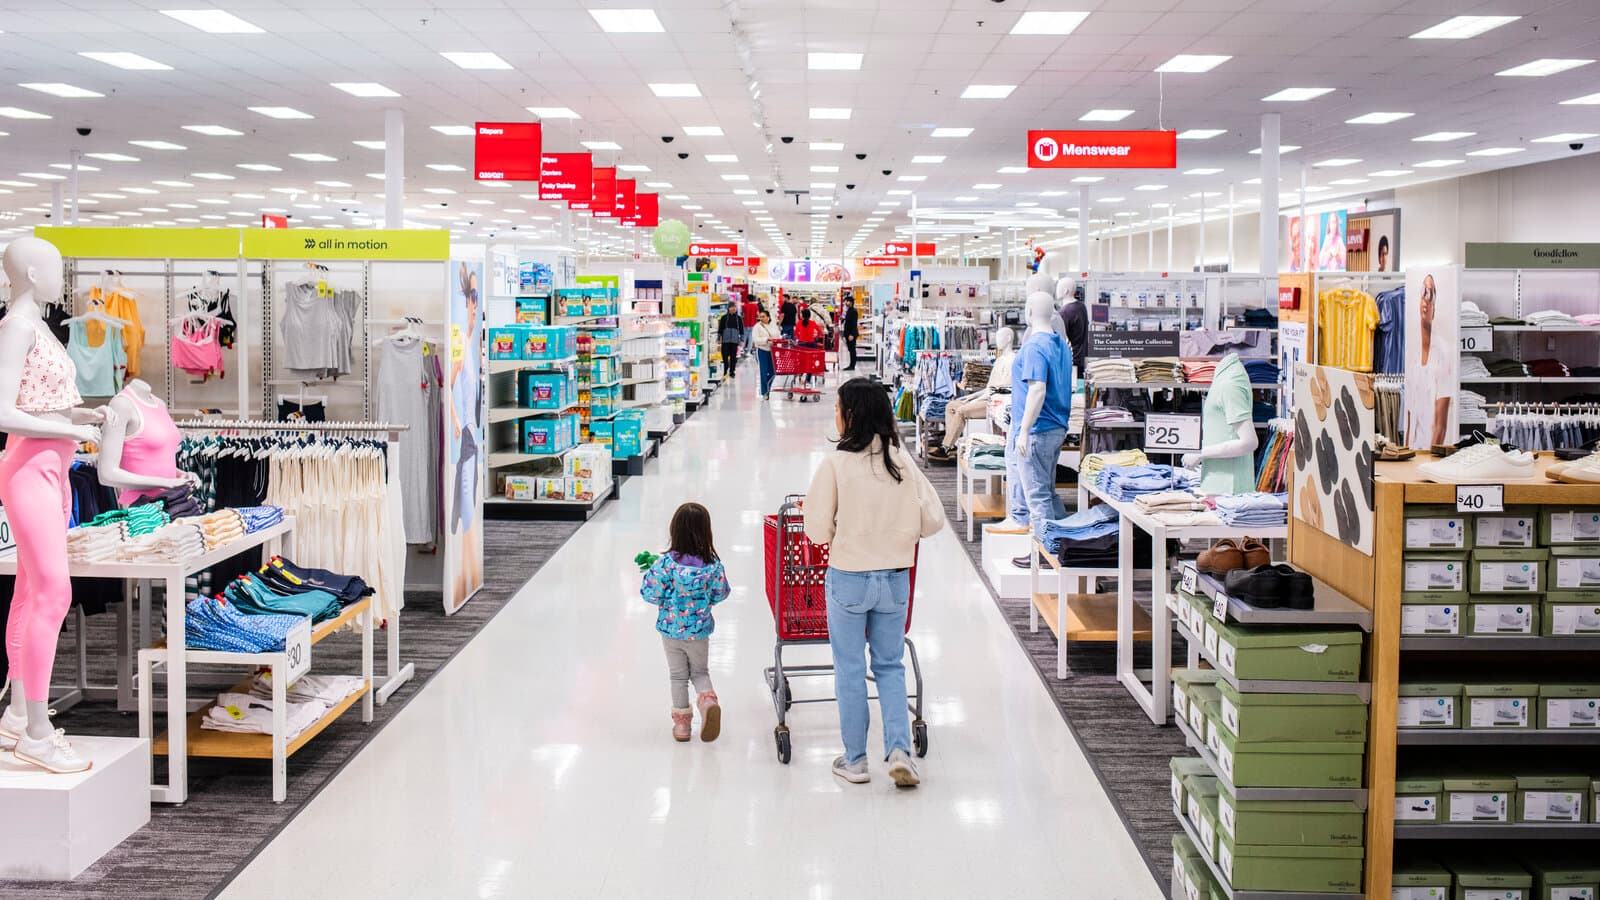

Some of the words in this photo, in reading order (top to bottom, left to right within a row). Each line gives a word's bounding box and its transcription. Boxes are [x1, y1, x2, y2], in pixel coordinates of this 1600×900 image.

[1062, 143, 1131, 156] Menswear
[318, 239, 332, 249] all
[334, 239, 345, 249] in
[347, 239, 388, 250] motion
[1533, 248, 1578, 258] Goodfellow
[1149, 426, 1179, 444] $25
[1458, 494, 1484, 509] $40
[288, 643, 301, 669] $30
